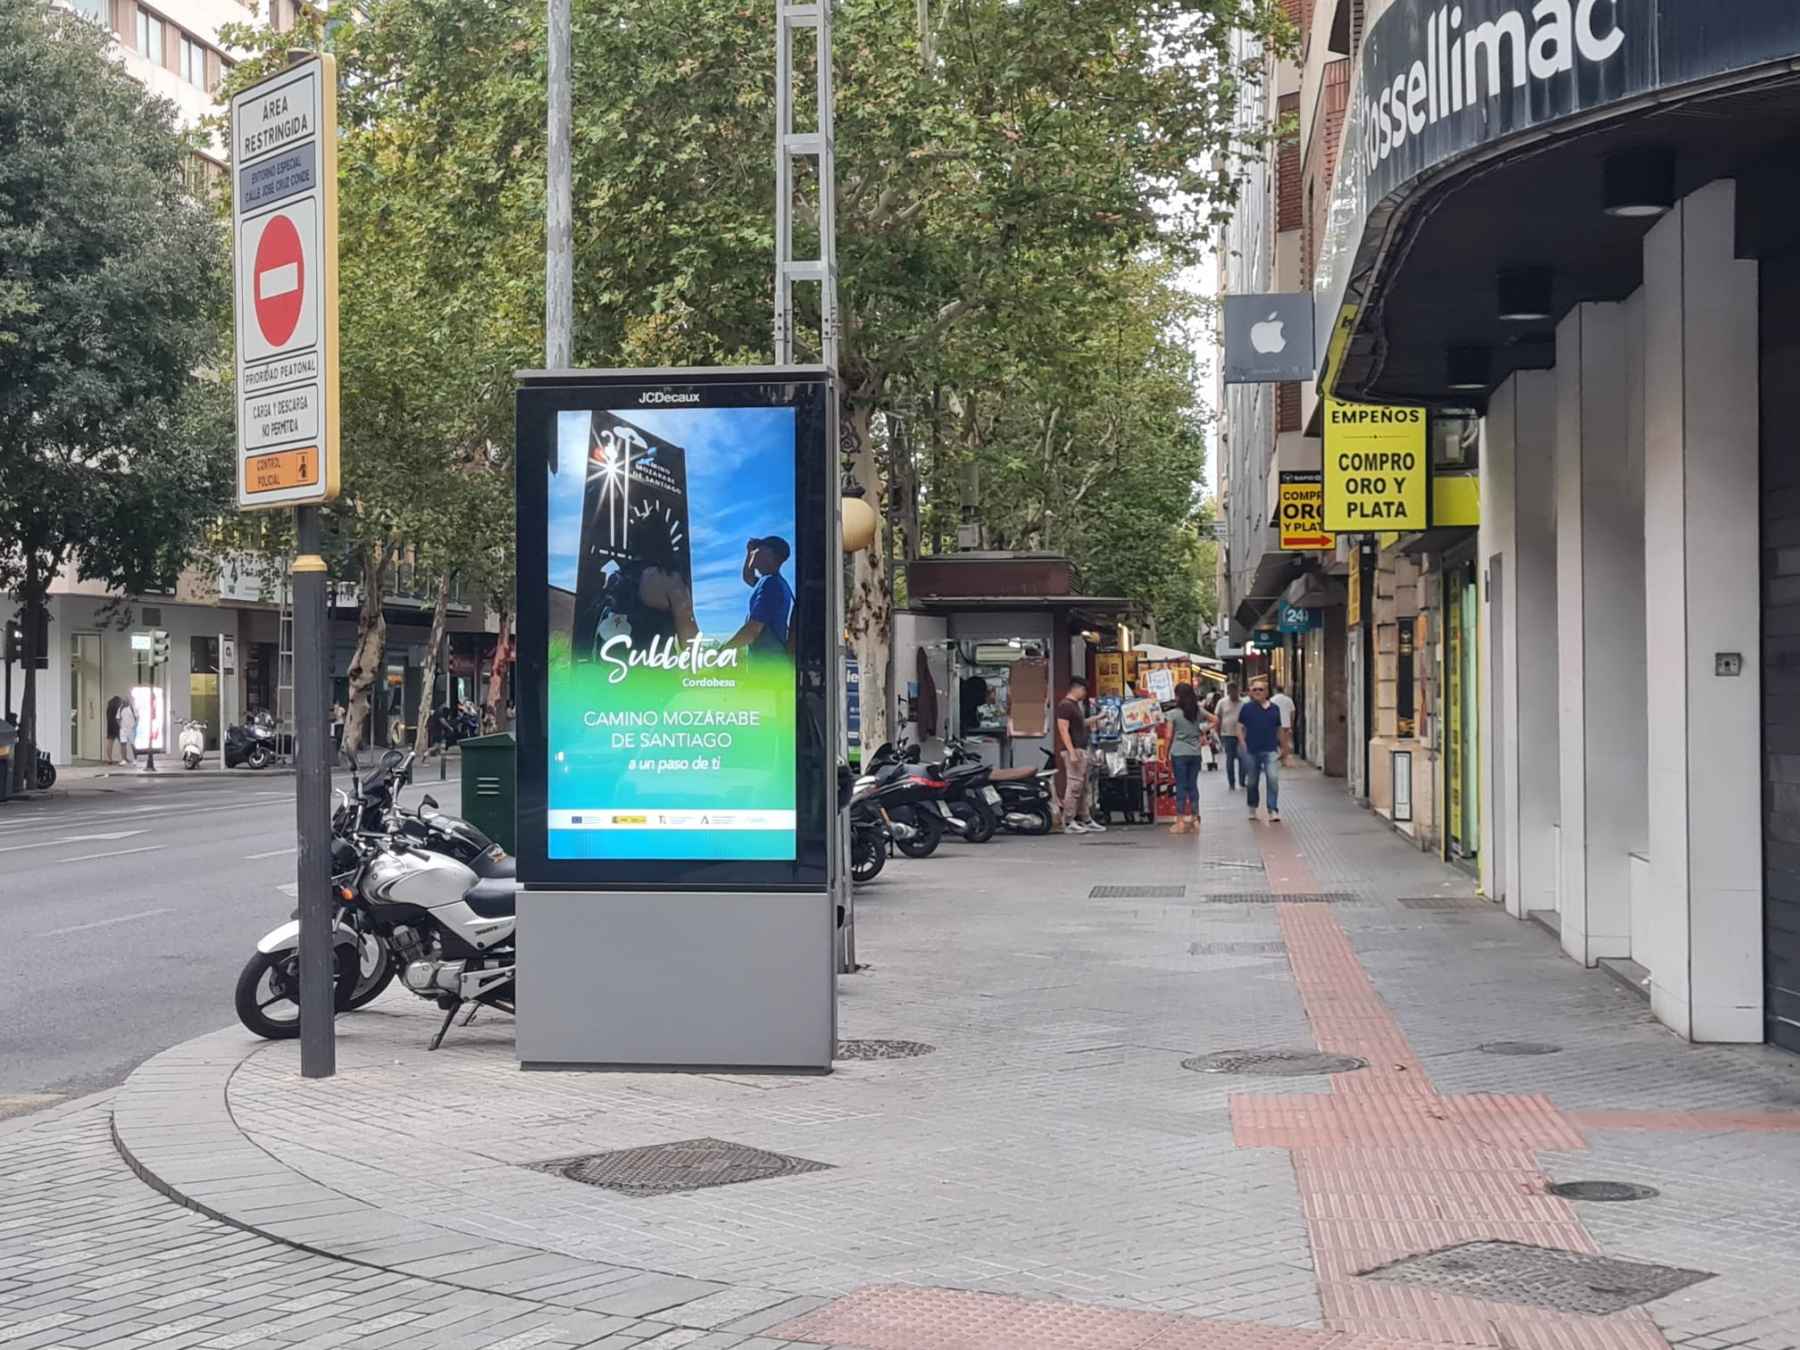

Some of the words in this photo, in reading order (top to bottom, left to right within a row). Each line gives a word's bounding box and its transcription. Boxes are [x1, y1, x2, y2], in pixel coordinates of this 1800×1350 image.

[244, 113, 308, 155] RESTRINGIDA
[245, 367, 279, 386] PRIORIDAD
[280, 359, 316, 379] PEATONAL
[638, 391, 700, 404] JCDecaux
[253, 403, 271, 419] CARGA
[277, 396, 308, 415] DESCARGA
[1331, 406, 1420, 424] EMPEÑOS
[262, 423, 270, 439] NO
[1338, 453, 1415, 471] COMPRO
[1345, 478, 1387, 495] ORO
[1392, 477, 1407, 494] Y
[1283, 491, 1322, 501] COMPR
[1347, 501, 1408, 518] PLATA
[1283, 522, 1291, 532] Y
[1287, 608, 1305, 623] 24
[682, 676, 736, 688] Cordobesa
[584, 710, 658, 727] CAMINO
[611, 733, 635, 748] DE
[640, 732, 732, 748] SANTIAGO
[628, 760, 637, 770] a
[639, 760, 655, 770] un
[657, 759, 689, 774] paso
[692, 755, 709, 770] de
[711, 756, 721, 770] ti
